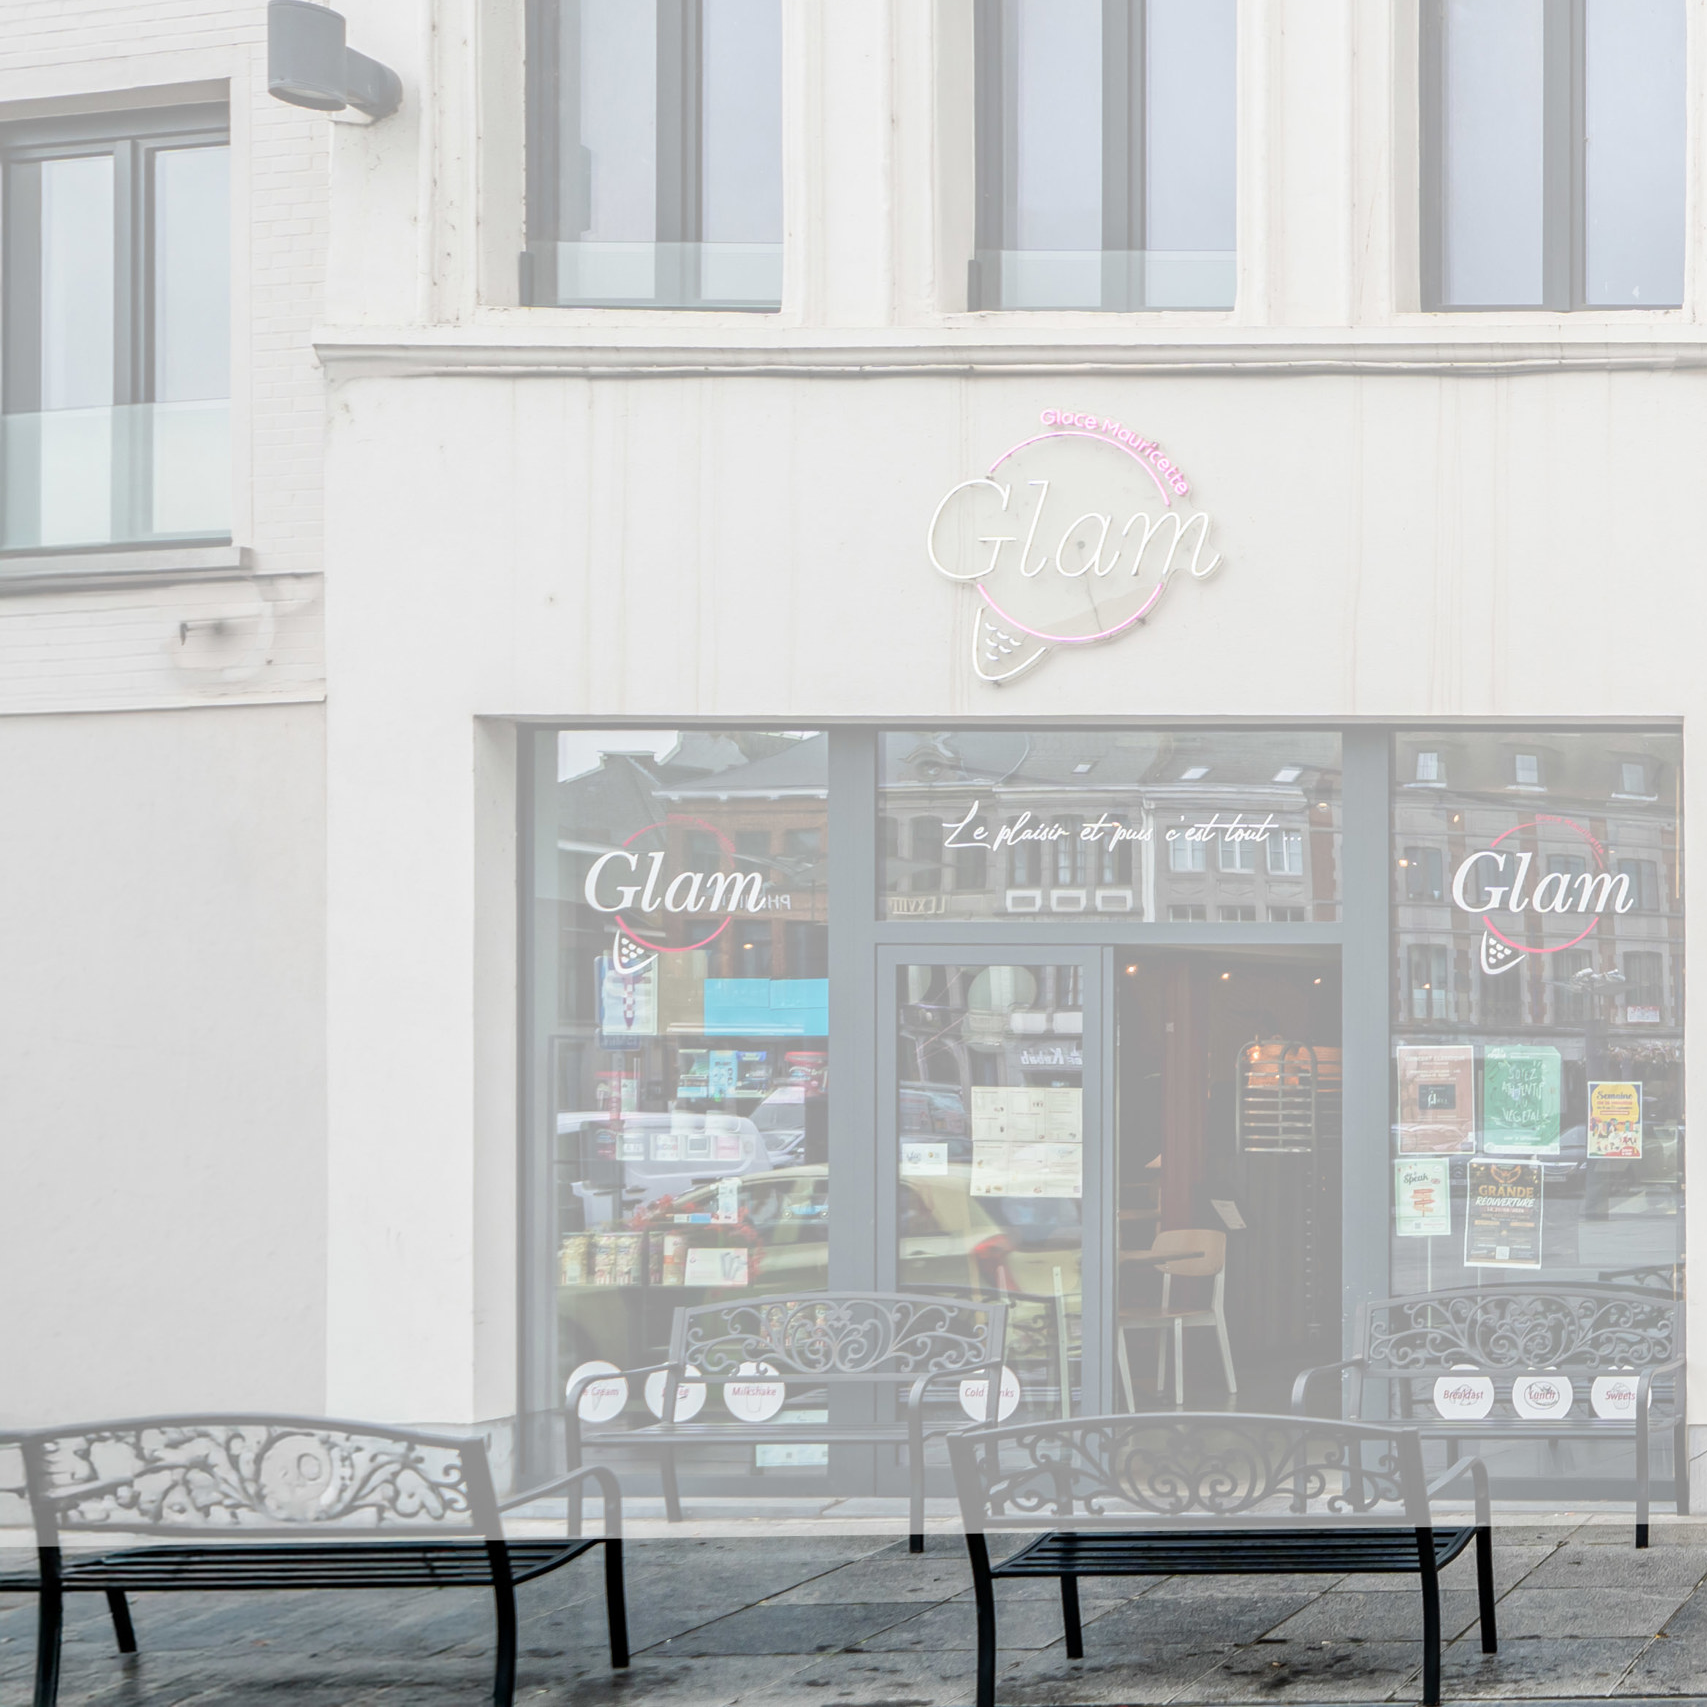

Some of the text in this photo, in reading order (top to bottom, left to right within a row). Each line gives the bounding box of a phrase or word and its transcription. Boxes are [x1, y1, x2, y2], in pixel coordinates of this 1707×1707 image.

[1040, 408, 1190, 497] Glace Mauricette
[927, 478, 1224, 579] Glam
[942, 800, 991, 849] Le
[993, 811, 1070, 851] plaisir
[1080, 813, 1120, 842] et
[1224, 813, 1278, 842] tout
[584, 851, 766, 913] Glam
[1452, 851, 1634, 914] Glam
[1479, 1185, 1534, 1199] GRANDE
[731, 1387, 777, 1397] Milkshake
[965, 1387, 984, 1397] Cold
[1443, 1389, 1484, 1401] Breakfast
[1605, 1390, 1636, 1401] Sweets
